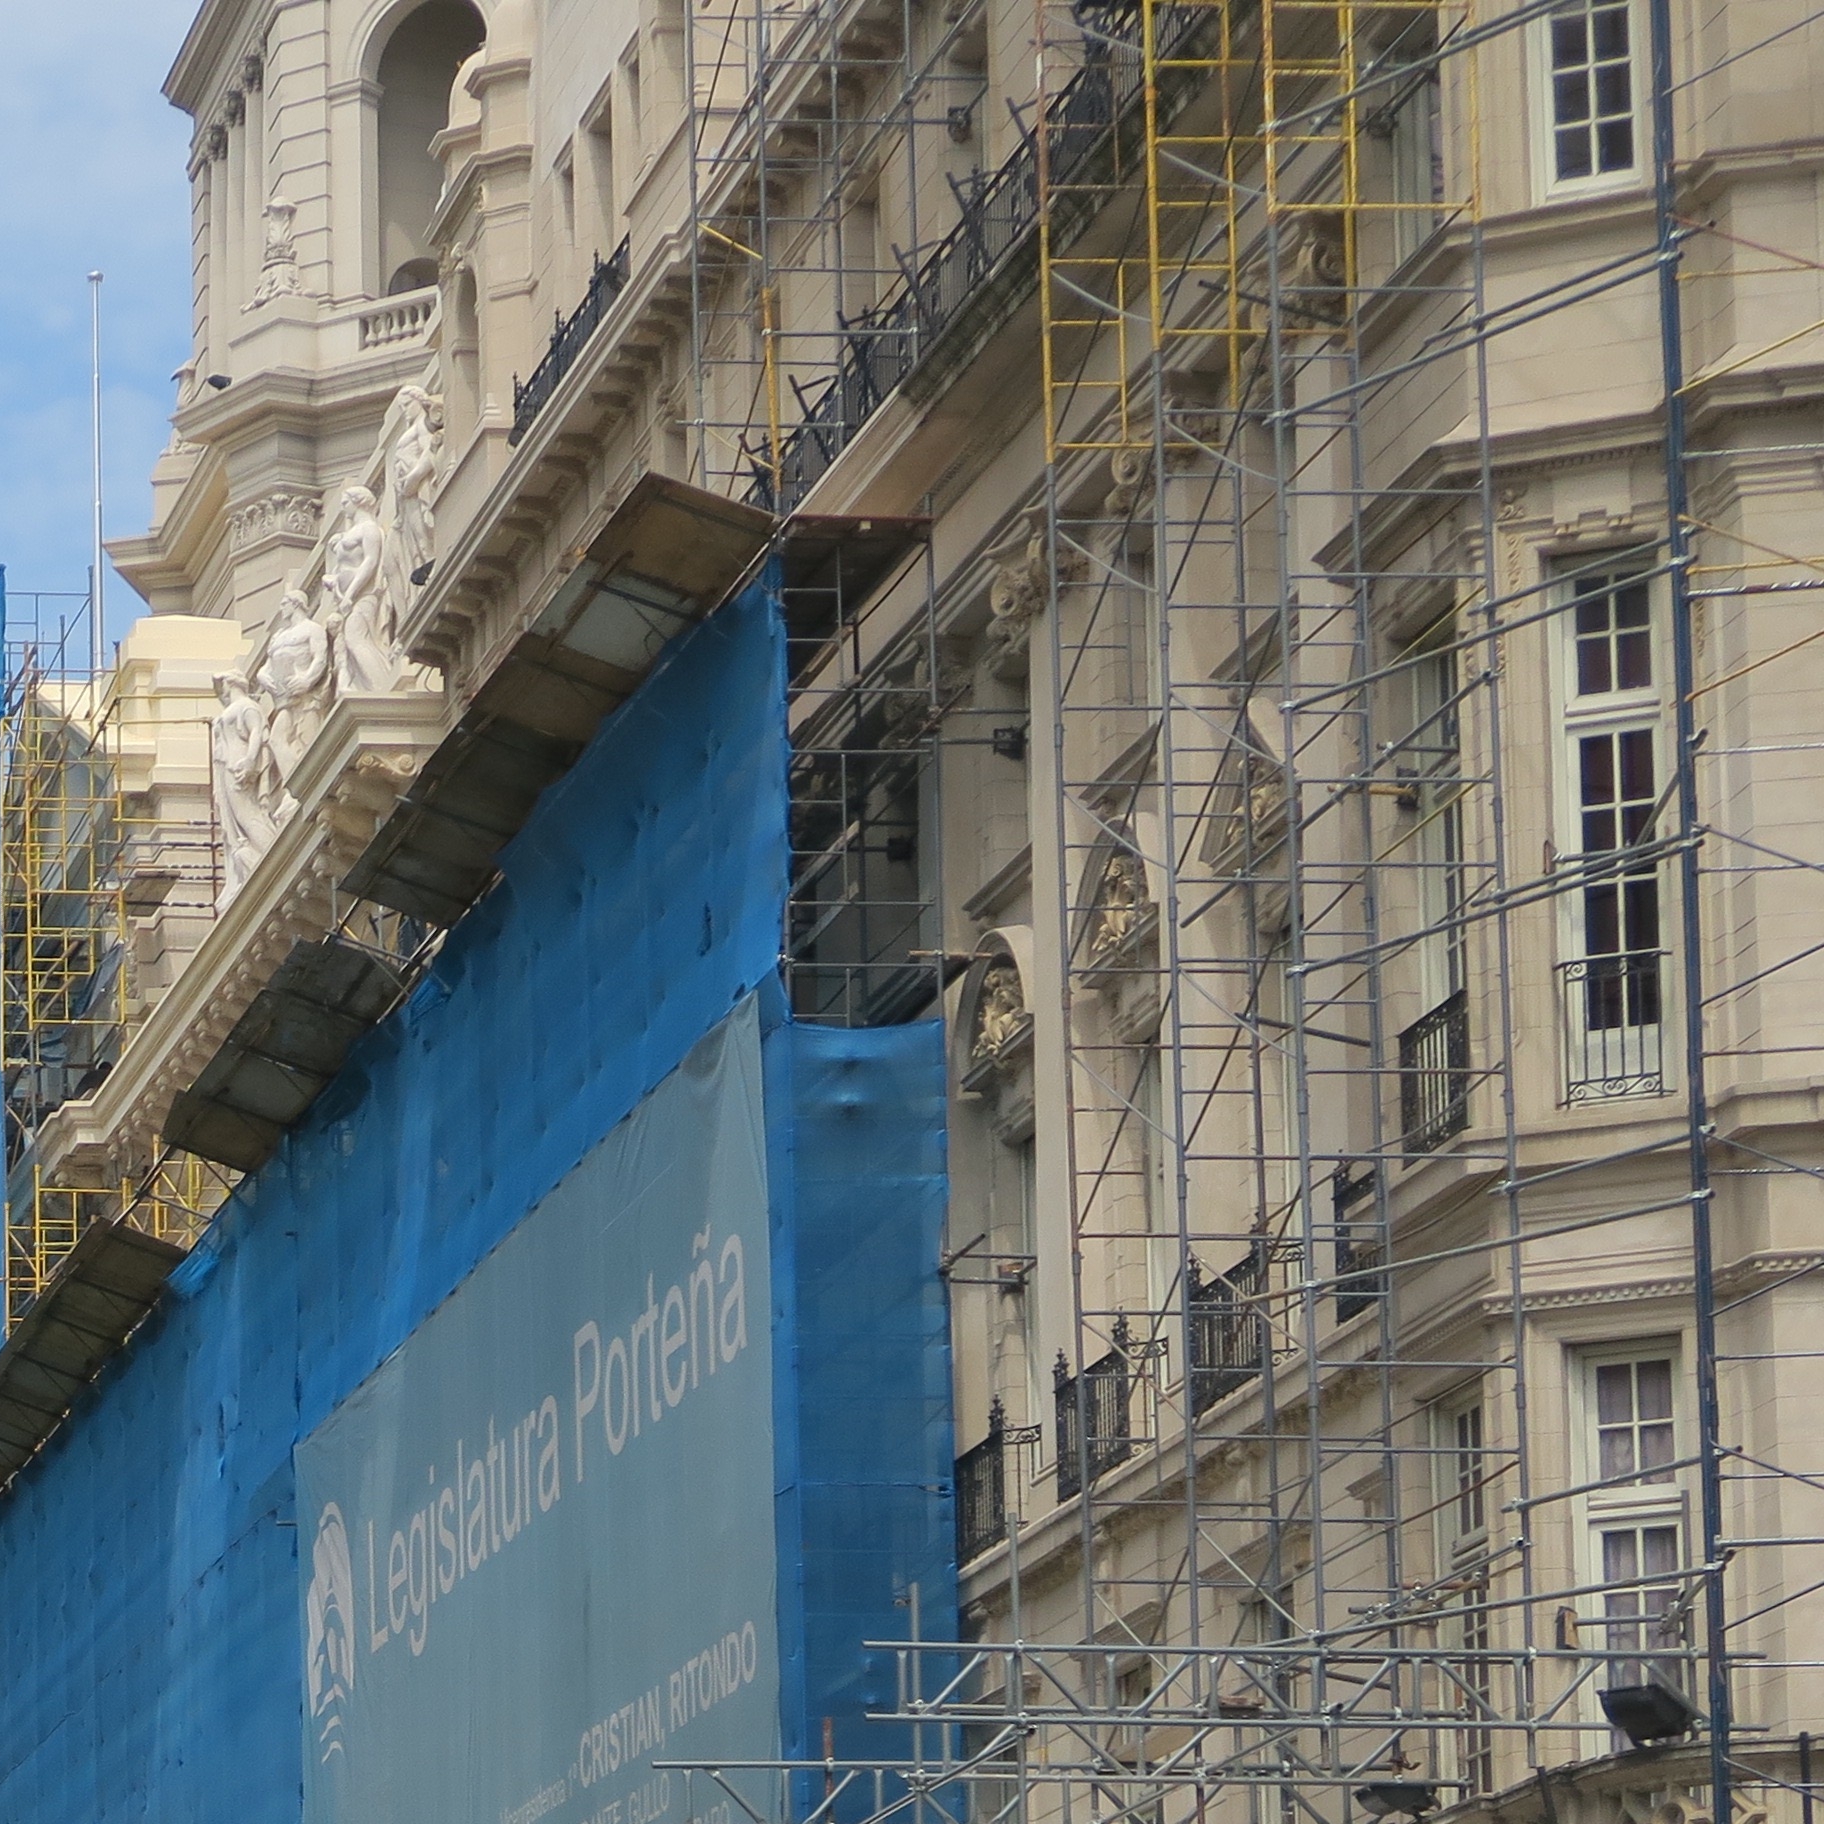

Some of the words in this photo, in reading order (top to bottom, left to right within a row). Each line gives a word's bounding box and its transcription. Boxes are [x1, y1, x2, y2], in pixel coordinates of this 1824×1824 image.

[368, 1394, 560, 1656] Legislatura
[573, 1222, 748, 1484] Porteña
[579, 1686, 665, 1788] CRISTIAN,
[669, 1620, 756, 1732] RITONDO
